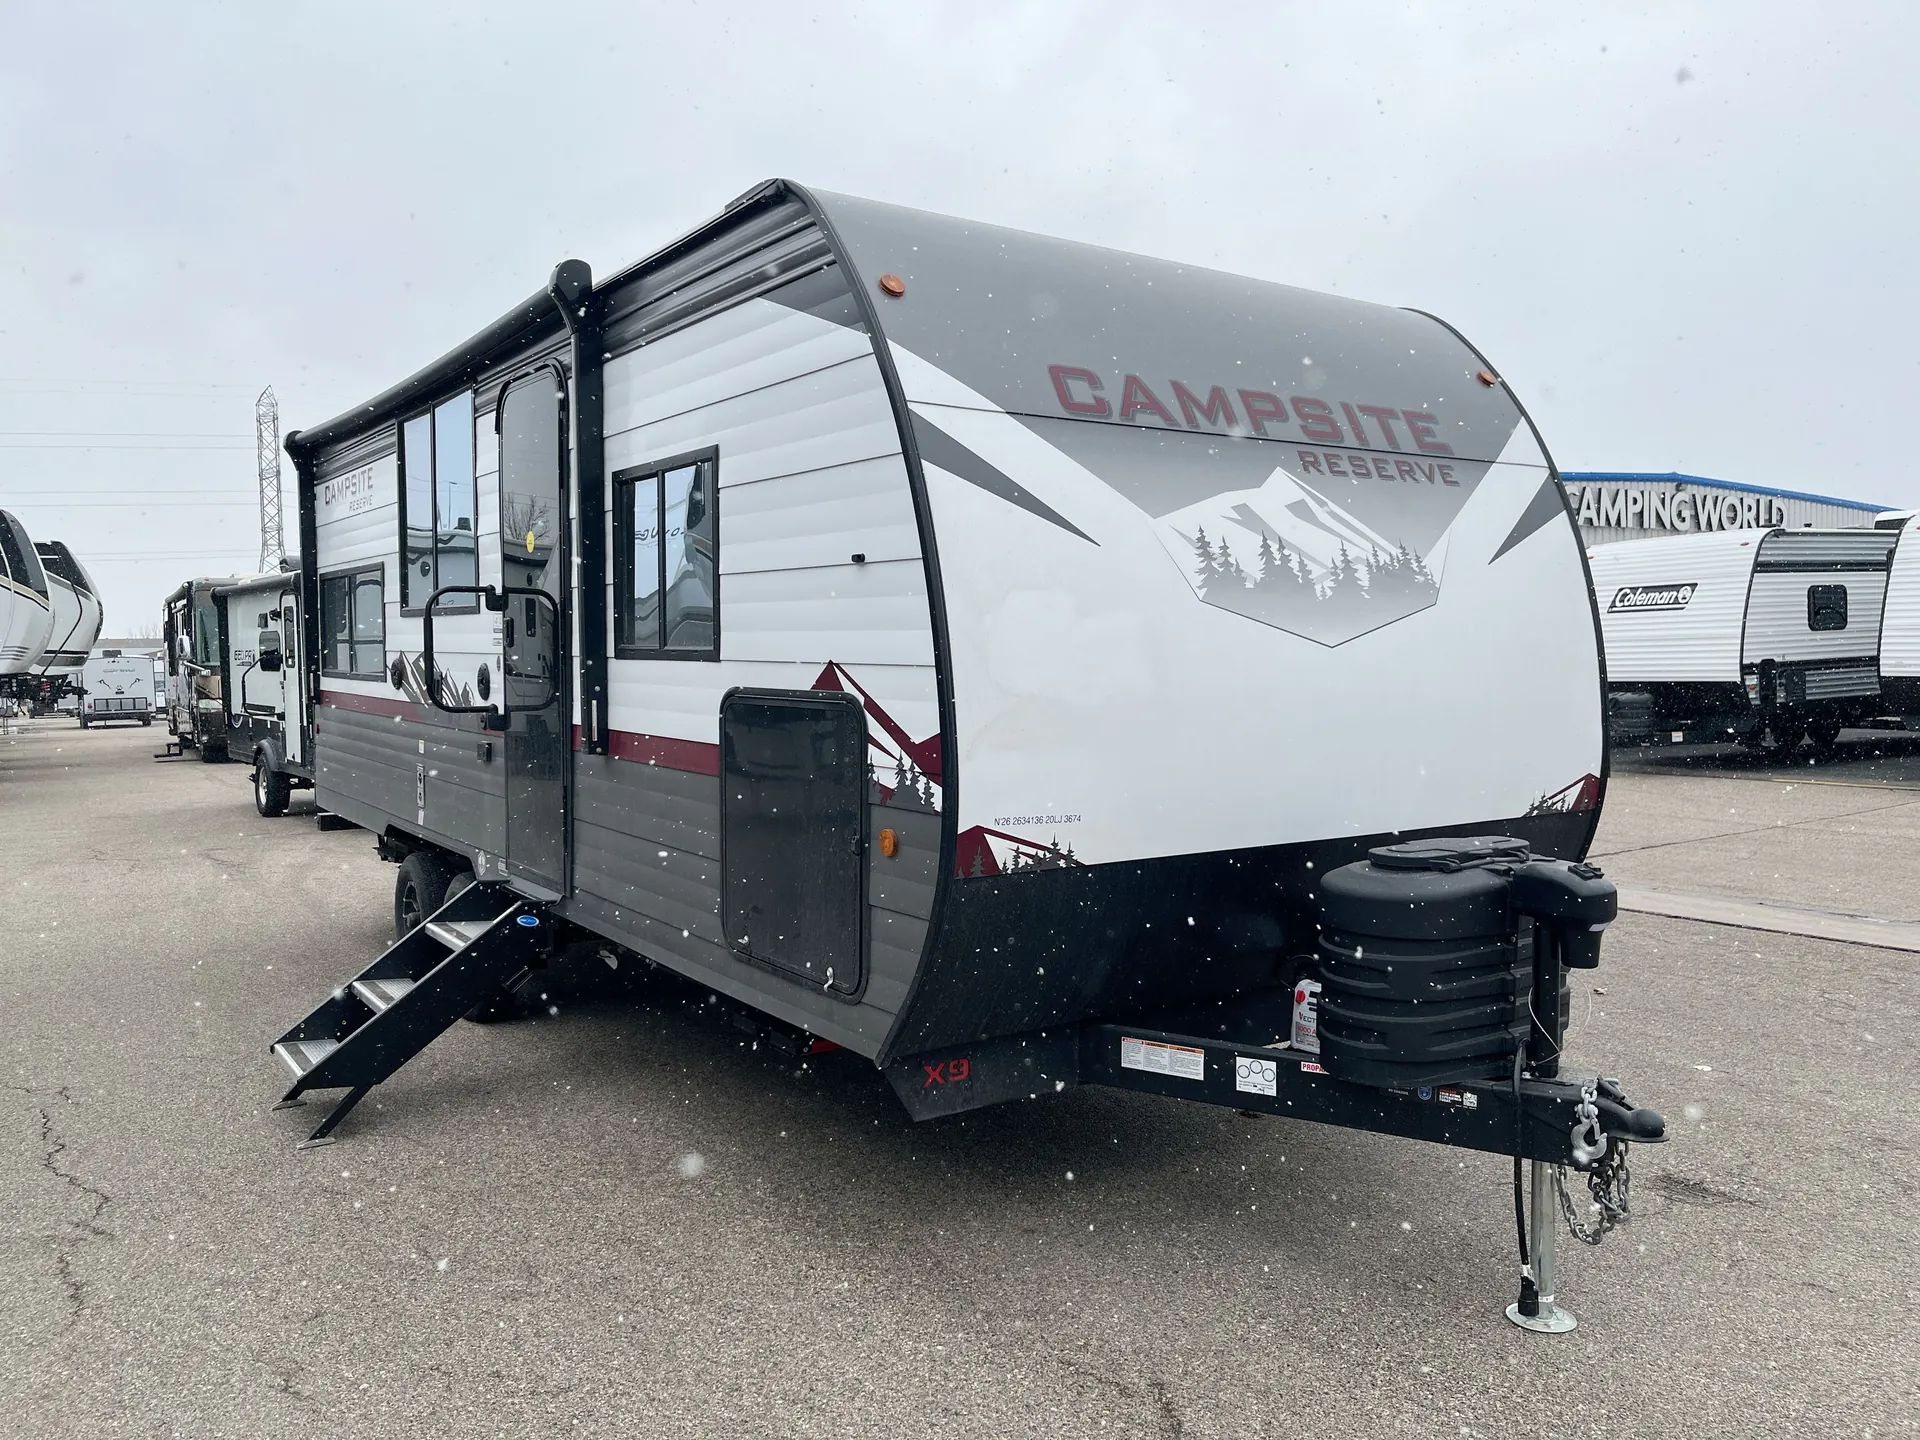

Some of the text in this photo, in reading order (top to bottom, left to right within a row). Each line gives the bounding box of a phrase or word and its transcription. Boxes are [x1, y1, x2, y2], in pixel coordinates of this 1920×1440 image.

[1047, 364, 1454, 455] CAMPSITE
[1296, 450, 1461, 486] RESERVE
[325, 467, 374, 505] CAMPSITE
[349, 494, 374, 512] RESERVE
[1695, 492, 1788, 531] WORLD
[1615, 588, 1678, 607] Coleman
[1012, 815, 1044, 825] 2634136
[1064, 814, 1081, 823] 3674
[923, 1058, 969, 1088] X9
[1303, 1063, 1326, 1073] PROPA
